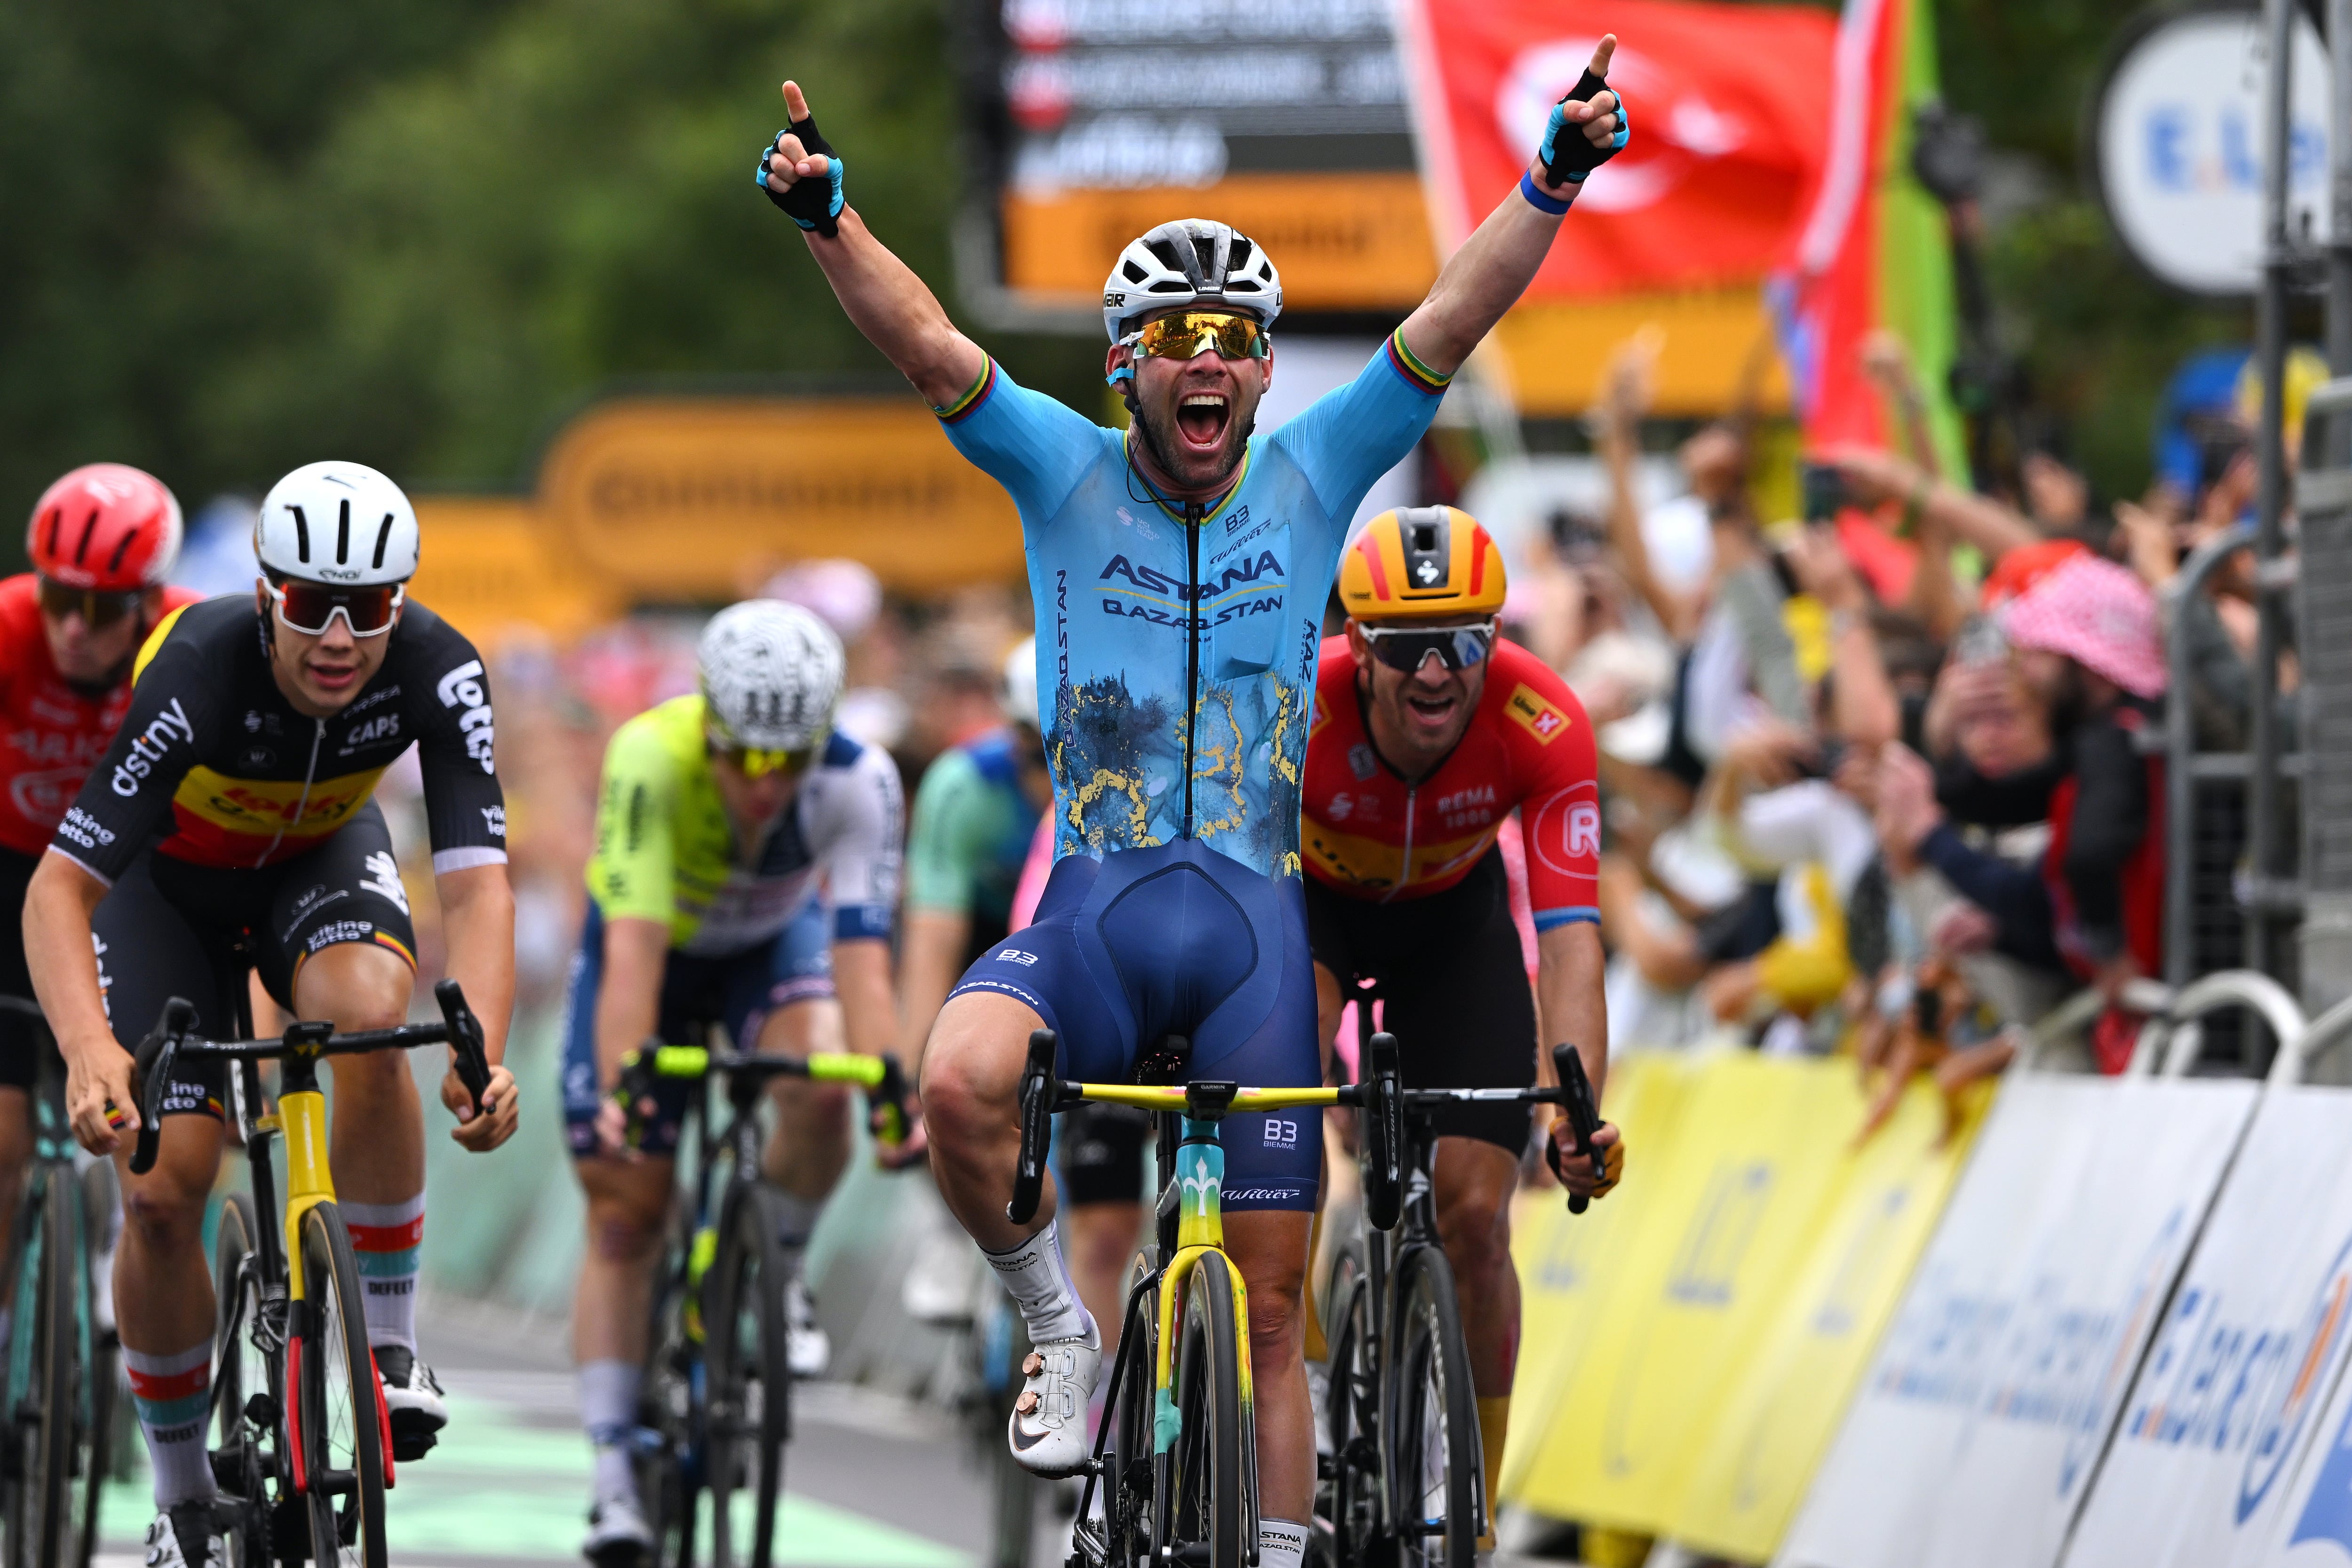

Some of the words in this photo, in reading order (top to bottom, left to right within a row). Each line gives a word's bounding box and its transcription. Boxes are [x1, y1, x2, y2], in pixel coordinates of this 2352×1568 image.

[1225, 505, 1249, 532] B3
[1227, 517, 1250, 537] BIEMME
[1210, 522, 1271, 564] Wilier
[1099, 550, 1285, 601] ASTANA
[1057, 569, 1075, 749] QAZAQSTAN
[1302, 620, 1317, 682] KAZ
[347, 713, 399, 745] CAPS
[111, 697, 194, 797] dstny
[995, 958, 1032, 967] BIEMME
[998, 949, 1039, 964] B3
[1264, 1119, 1297, 1142] B3
[1263, 1140, 1296, 1150] BIEMME
[1221, 1188, 1300, 1201] Wilier
[1260, 1531, 1302, 1545] STANA
[1260, 1544, 1300, 1554] AZAQSTAN
